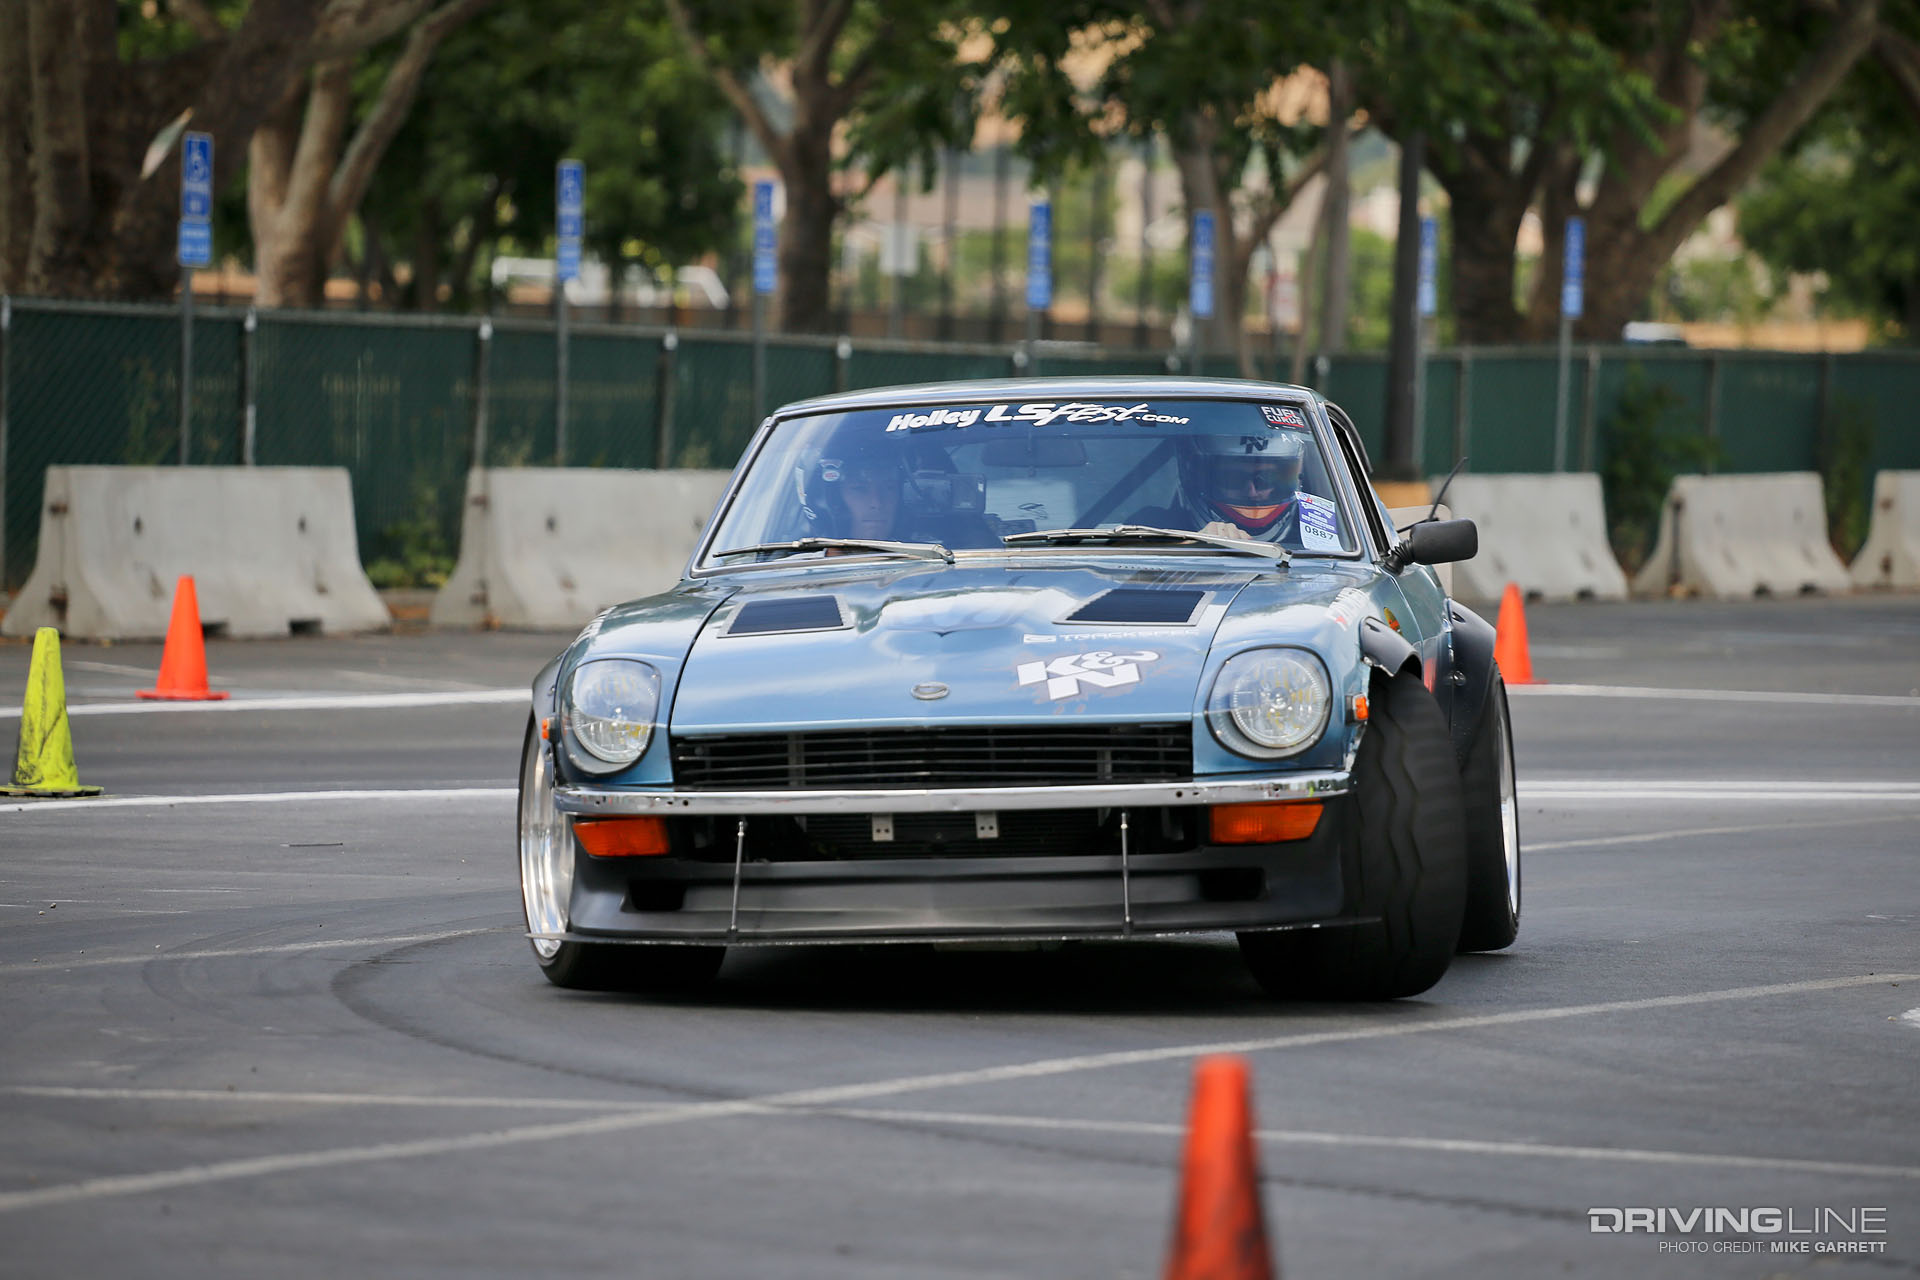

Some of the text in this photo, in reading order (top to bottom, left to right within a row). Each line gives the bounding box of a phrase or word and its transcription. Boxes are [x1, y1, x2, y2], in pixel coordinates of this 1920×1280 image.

[885, 408, 982, 433] Holley
[1260, 406, 1298, 418] FUEL
[1304, 525, 1334, 540] 0887
[1016, 650, 1161, 701] K&N
